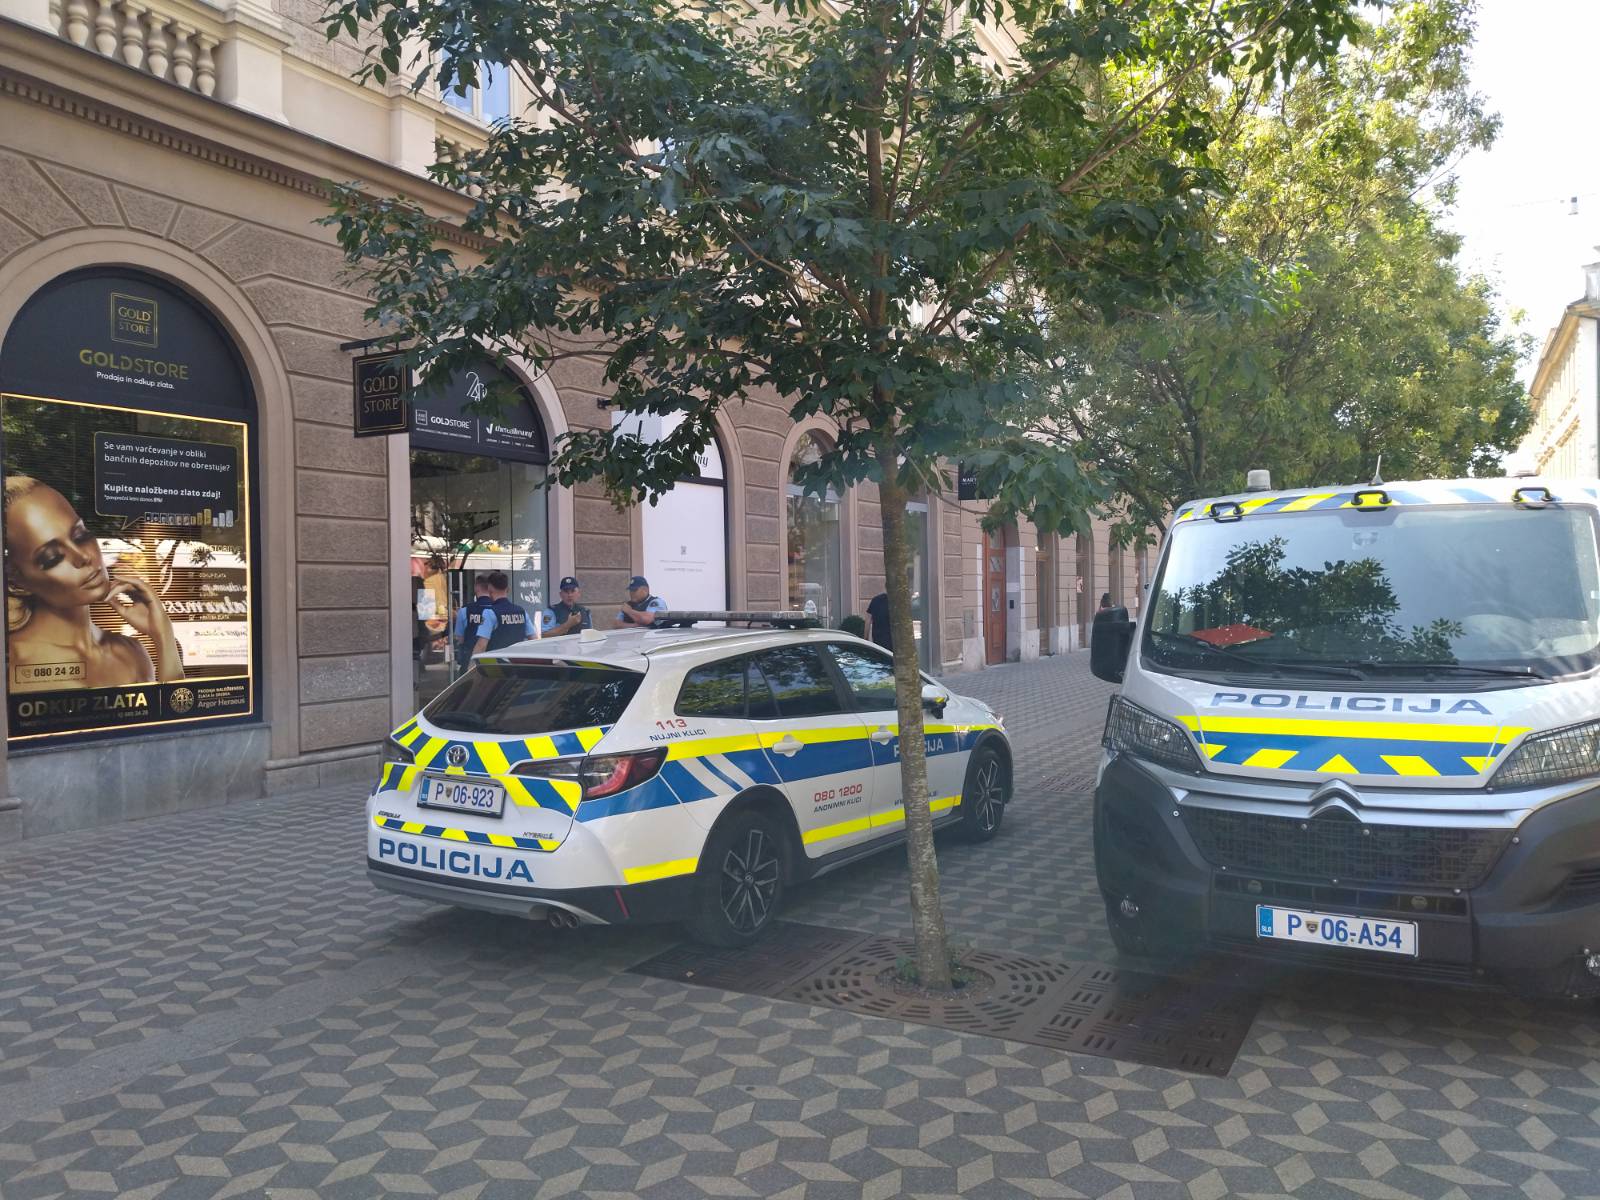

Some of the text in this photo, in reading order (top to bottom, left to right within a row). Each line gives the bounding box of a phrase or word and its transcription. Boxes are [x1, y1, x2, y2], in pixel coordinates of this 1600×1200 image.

[118, 306, 151, 321] GOLD
[119, 322, 151, 335] STORE
[79, 349, 189, 380] GOLDSTORE
[96, 371, 124, 383] Prodaja
[134, 378, 155, 387] odkup
[156, 381, 175, 389] zlata.
[363, 376, 398, 393] GOLD
[364, 397, 399, 414] STORE
[430, 415, 470, 429] GOLDSTORE
[104, 441, 114, 450] Se
[116, 444, 133, 452] vam
[135, 446, 178, 456] varčevanje
[185, 450, 207, 459] obliki
[104, 453, 138, 464] bančnih
[139, 457, 178, 468] depozitov
[191, 461, 231, 473] obrestuje?
[104, 483, 221, 500] Kupite naložbeno zlato zdaj!
[502, 614, 525, 624] POLICIJA
[34, 666, 80, 677] 080 24 28
[18, 692, 148, 717] ODKUP ZLATA
[1210, 692, 1493, 715] POLICIJA
[655, 718, 688, 730] 113
[649, 728, 707, 742] NUJNI KLICI
[893, 738, 944, 758] PIJA
[435, 782, 494, 808] P 06-923
[814, 783, 863, 803] 080 1200
[378, 837, 535, 883] POLICIJA
[1287, 914, 1402, 949] P 06-A54
